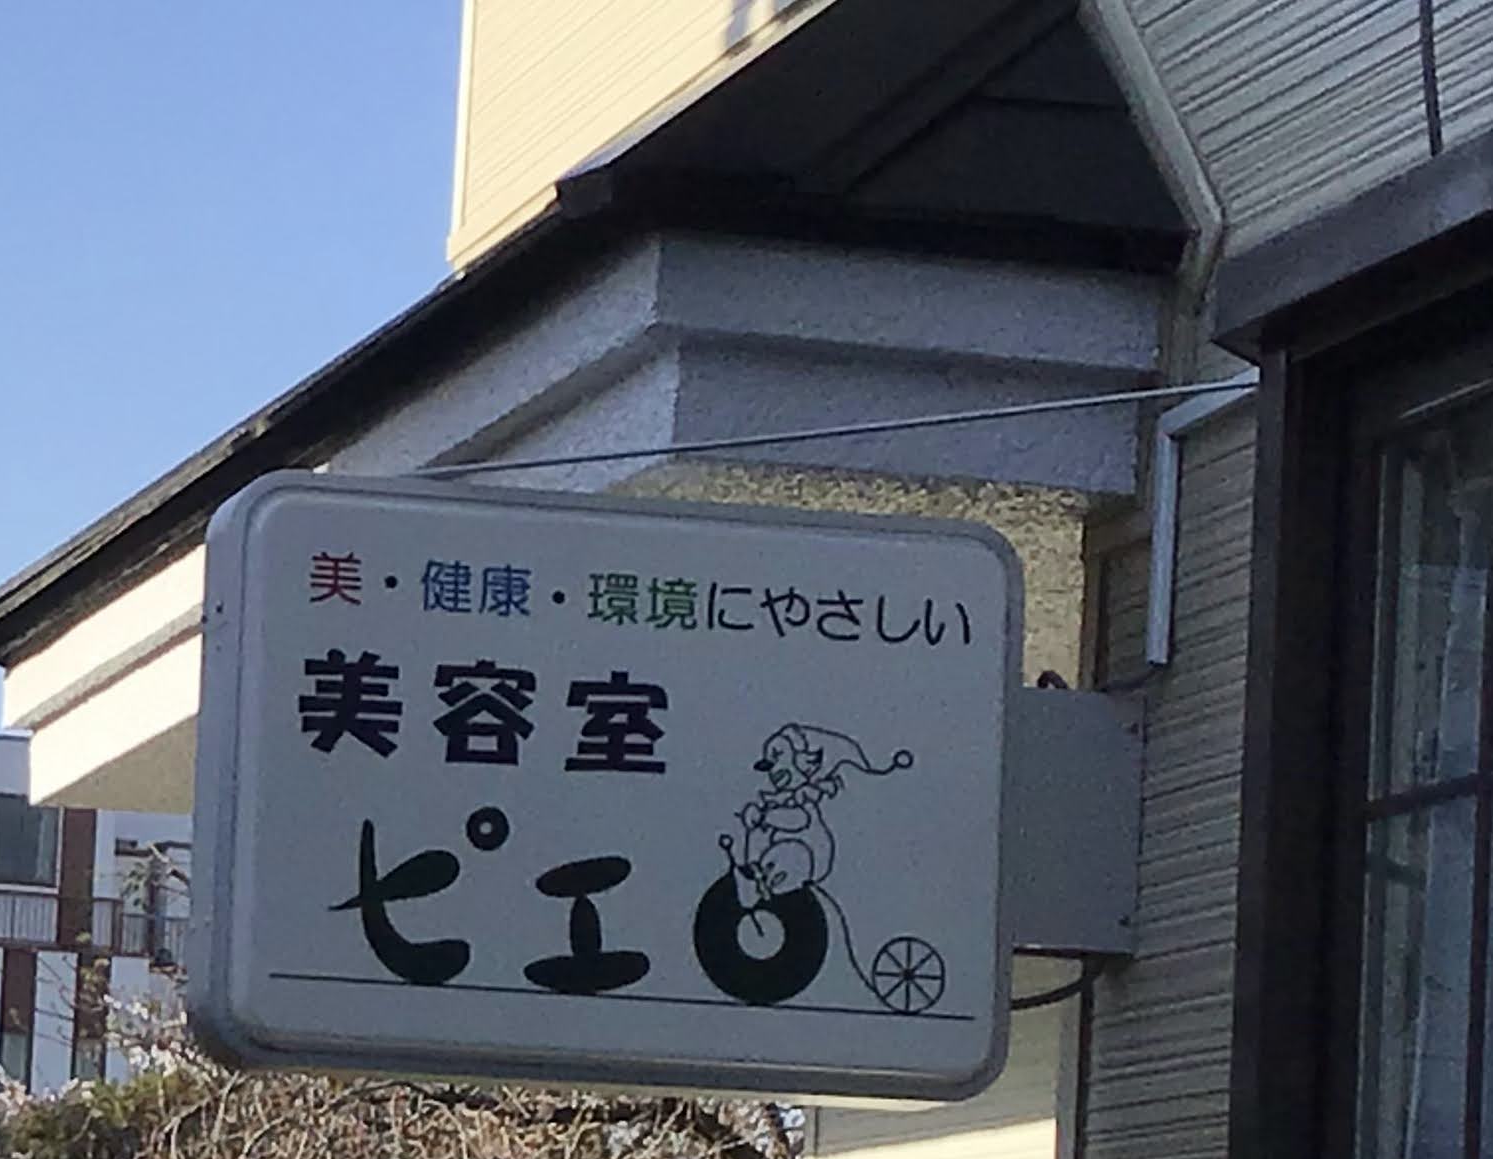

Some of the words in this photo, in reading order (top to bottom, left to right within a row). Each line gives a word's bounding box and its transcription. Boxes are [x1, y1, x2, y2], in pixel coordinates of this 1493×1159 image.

[309, 551, 971, 646] 美・健康・環境にやさしい
[297, 648, 670, 774] 美容室
